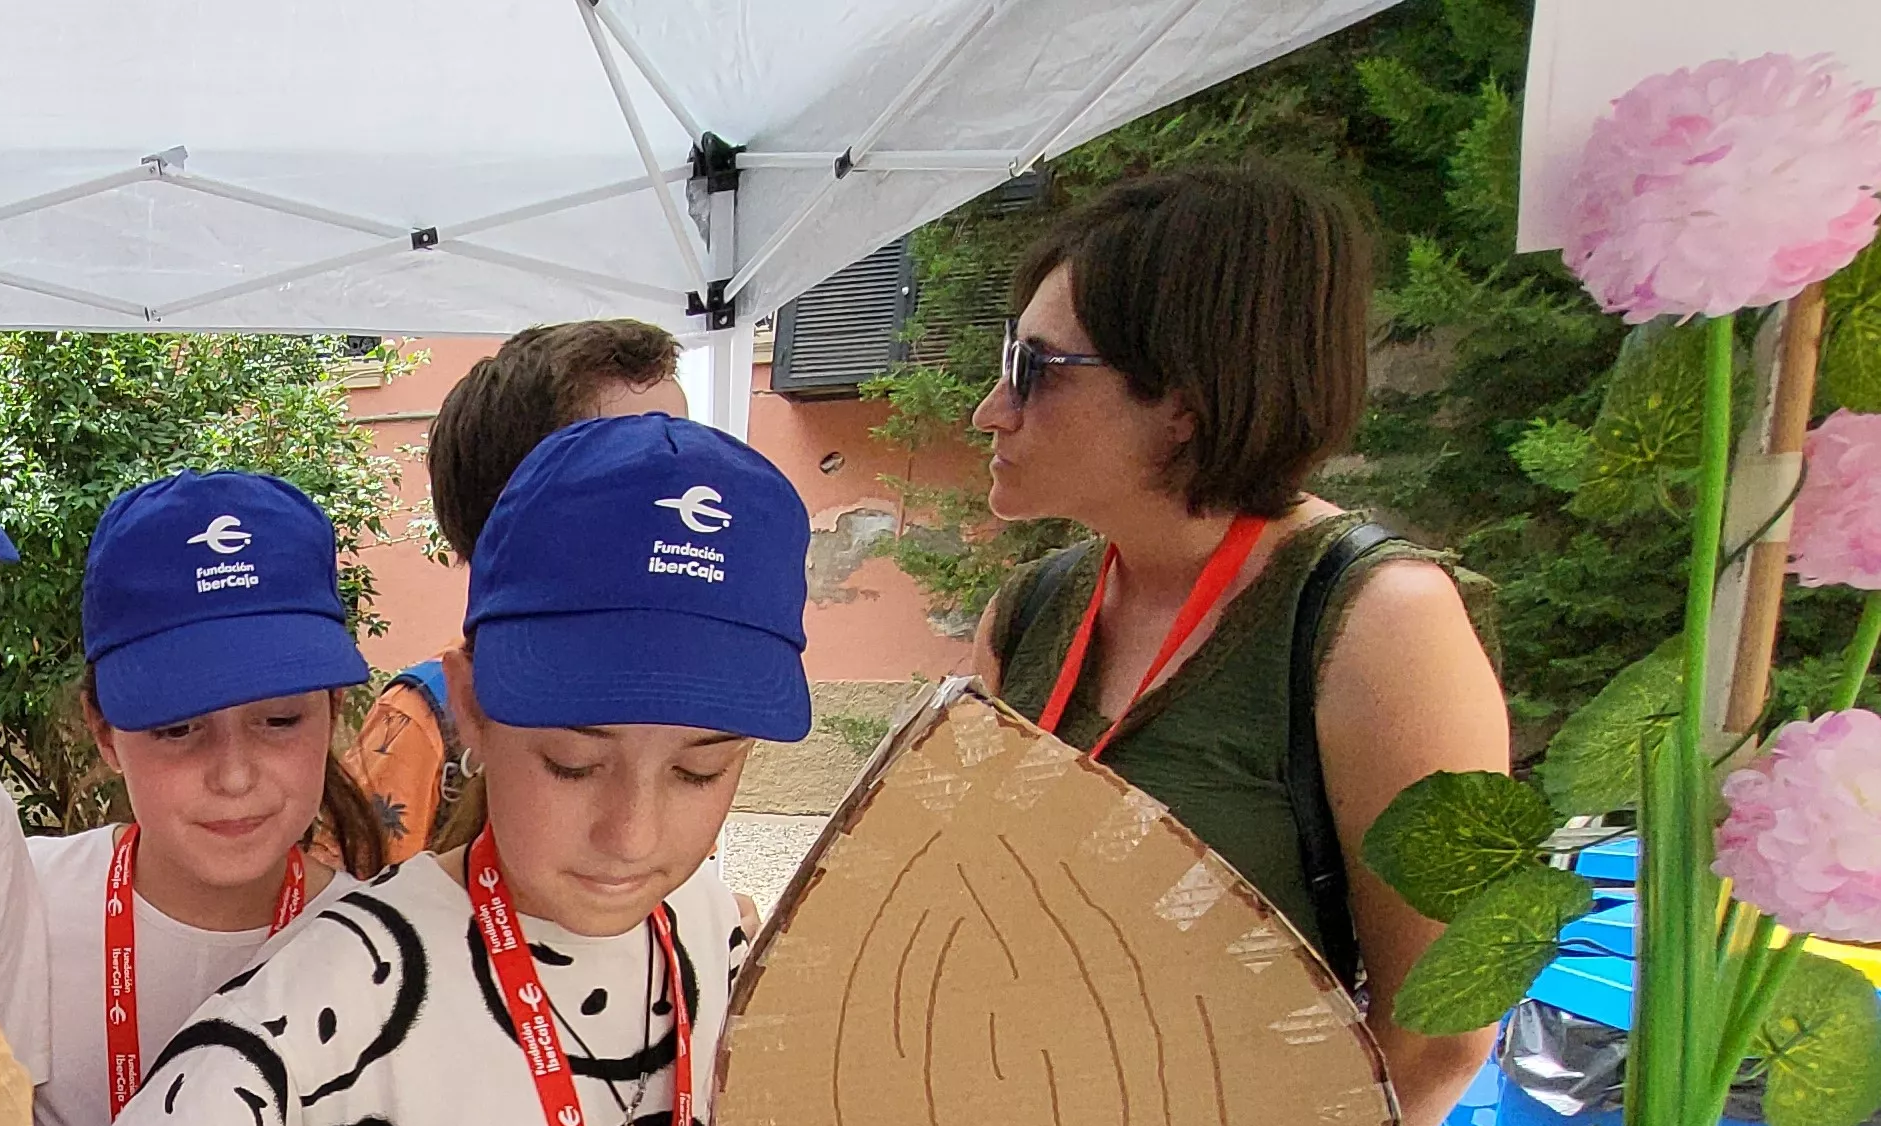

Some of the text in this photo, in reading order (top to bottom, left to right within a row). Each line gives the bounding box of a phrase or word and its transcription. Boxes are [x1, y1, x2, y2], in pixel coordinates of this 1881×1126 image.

[196, 561, 255, 578] Fundación
[654, 540, 725, 563] Fundación
[479, 903, 503, 954] Fundación
[122, 947, 132, 993] Fundación
[521, 1021, 547, 1076] Fundación
